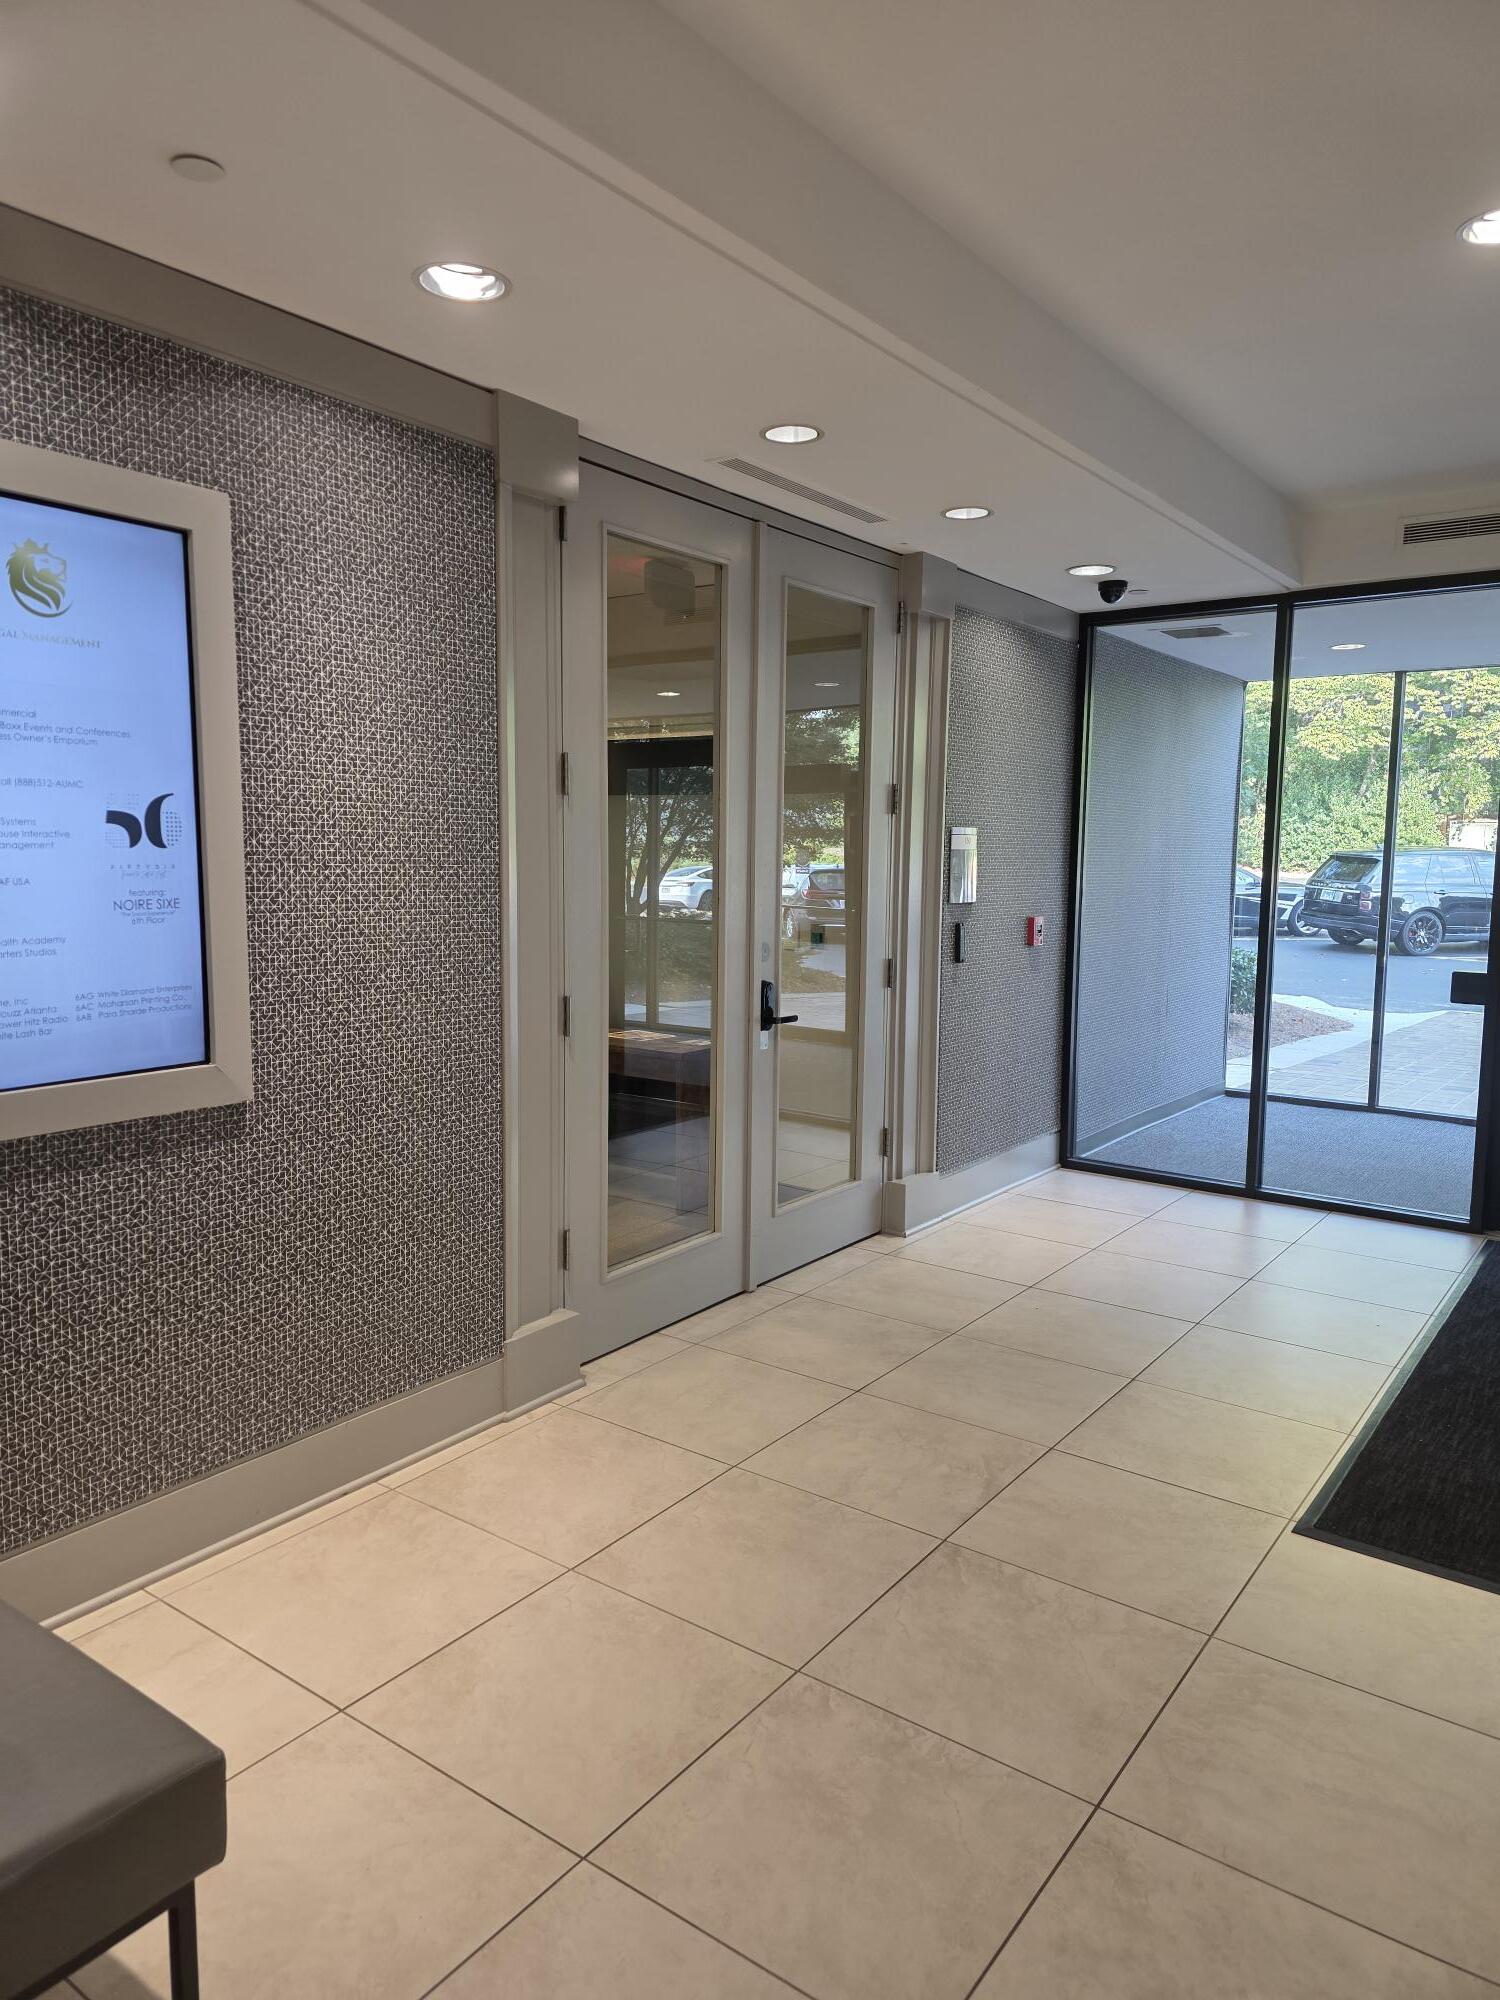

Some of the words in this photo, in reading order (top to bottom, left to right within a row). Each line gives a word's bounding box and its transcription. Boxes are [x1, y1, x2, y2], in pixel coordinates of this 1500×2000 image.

[55, 726, 73, 735] and
[75, 726, 131, 739] Conferences
[22, 829, 71, 840] Interactive
[12, 877, 31, 886] USA
[112, 898, 153, 912] NOIRE
[156, 897, 181, 910] SIXE
[22, 935, 67, 946] Academy
[24, 947, 57, 958] Studios
[42, 1015, 69, 1025] Radio
